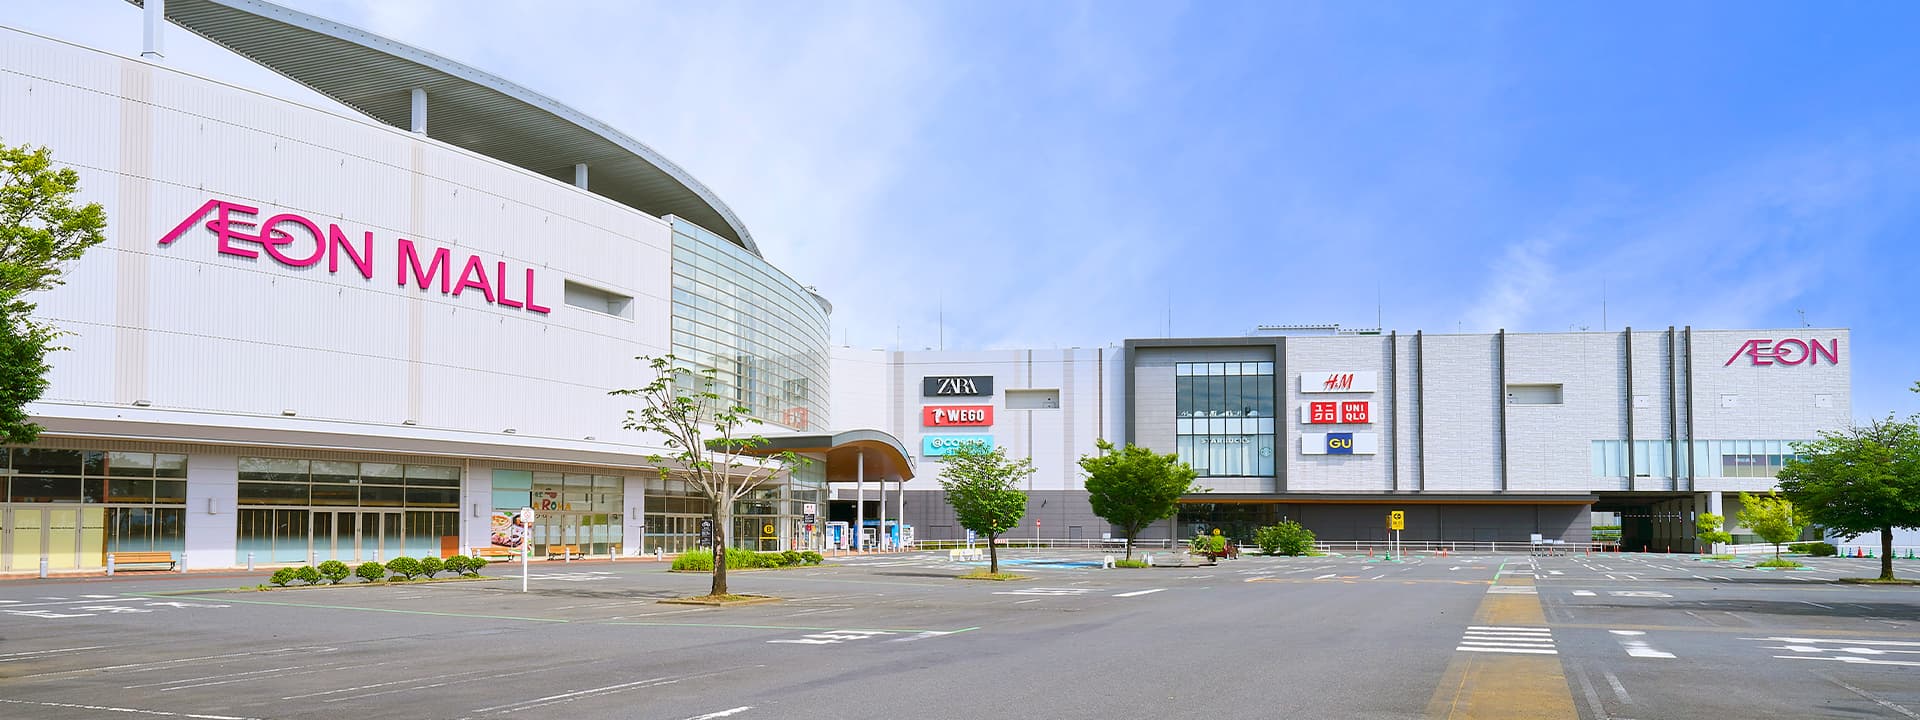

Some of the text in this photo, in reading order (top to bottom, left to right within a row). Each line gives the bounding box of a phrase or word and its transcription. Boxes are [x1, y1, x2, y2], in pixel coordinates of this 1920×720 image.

[398, 238, 551, 313] MALL
[937, 378, 978, 394] ZARA
[1323, 373, 1354, 390] H&M
[1315, 404, 1334, 412] ユニ
[947, 409, 984, 422] WEGO
[1346, 413, 1366, 421] QLO
[1329, 438, 1352, 449] GU
